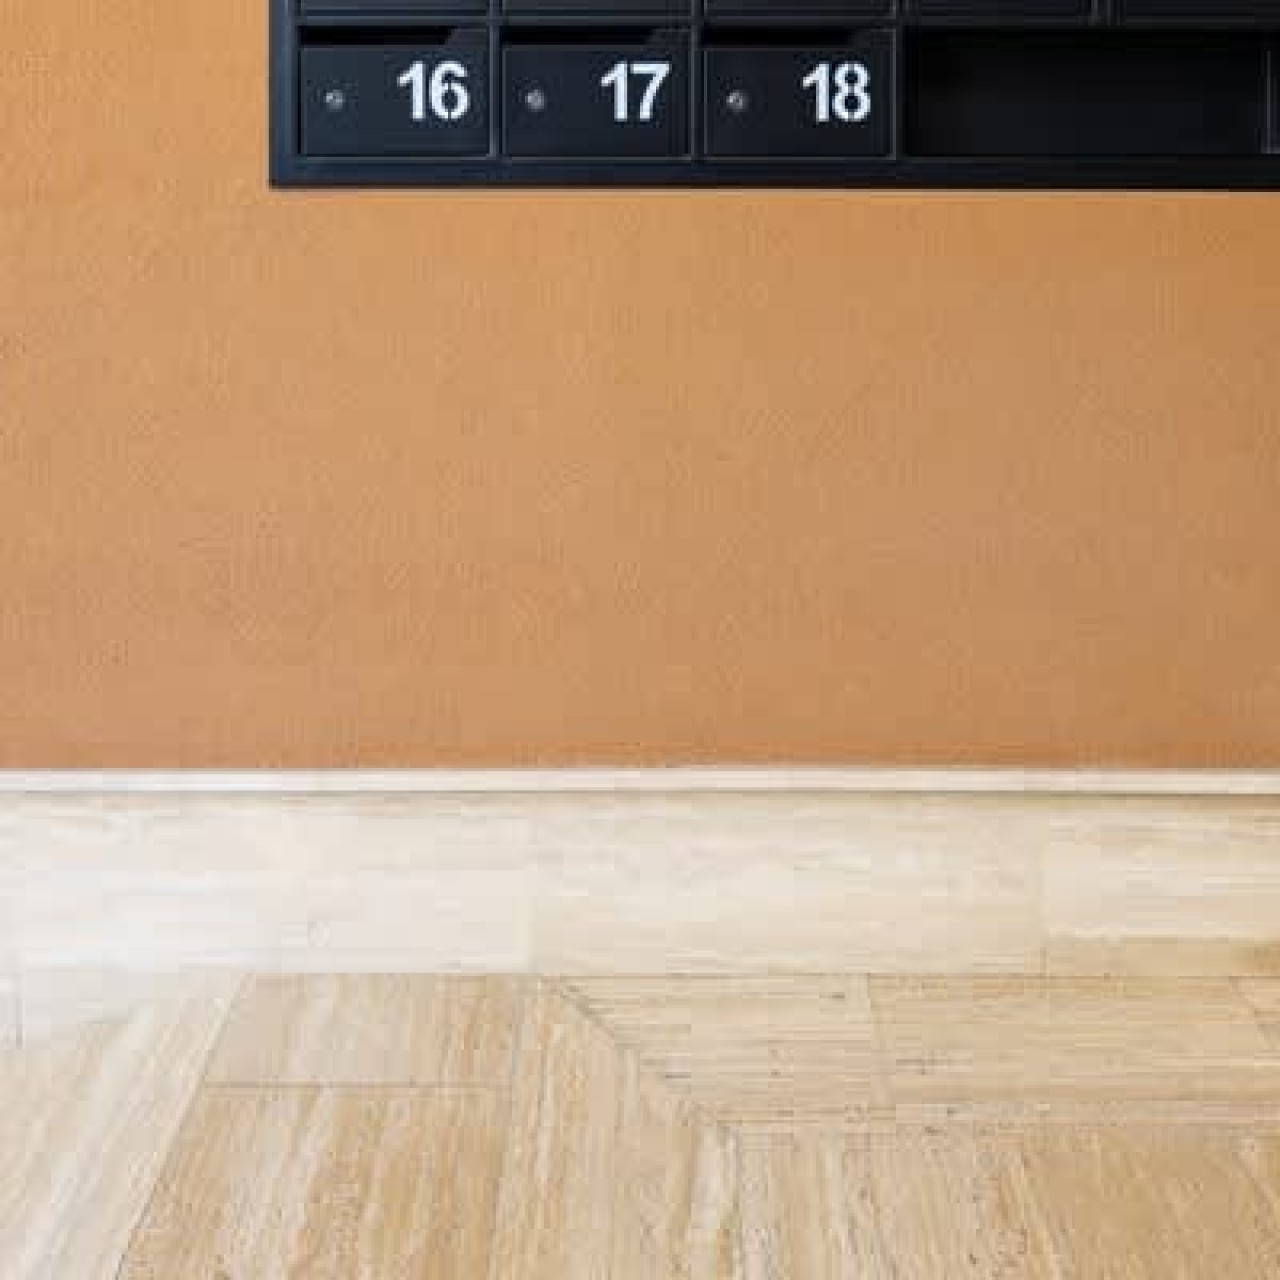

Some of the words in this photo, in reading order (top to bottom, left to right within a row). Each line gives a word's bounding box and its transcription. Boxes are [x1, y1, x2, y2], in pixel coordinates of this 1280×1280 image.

[396, 60, 470, 121] 16
[600, 62, 670, 121] 17
[802, 62, 871, 123] 18
